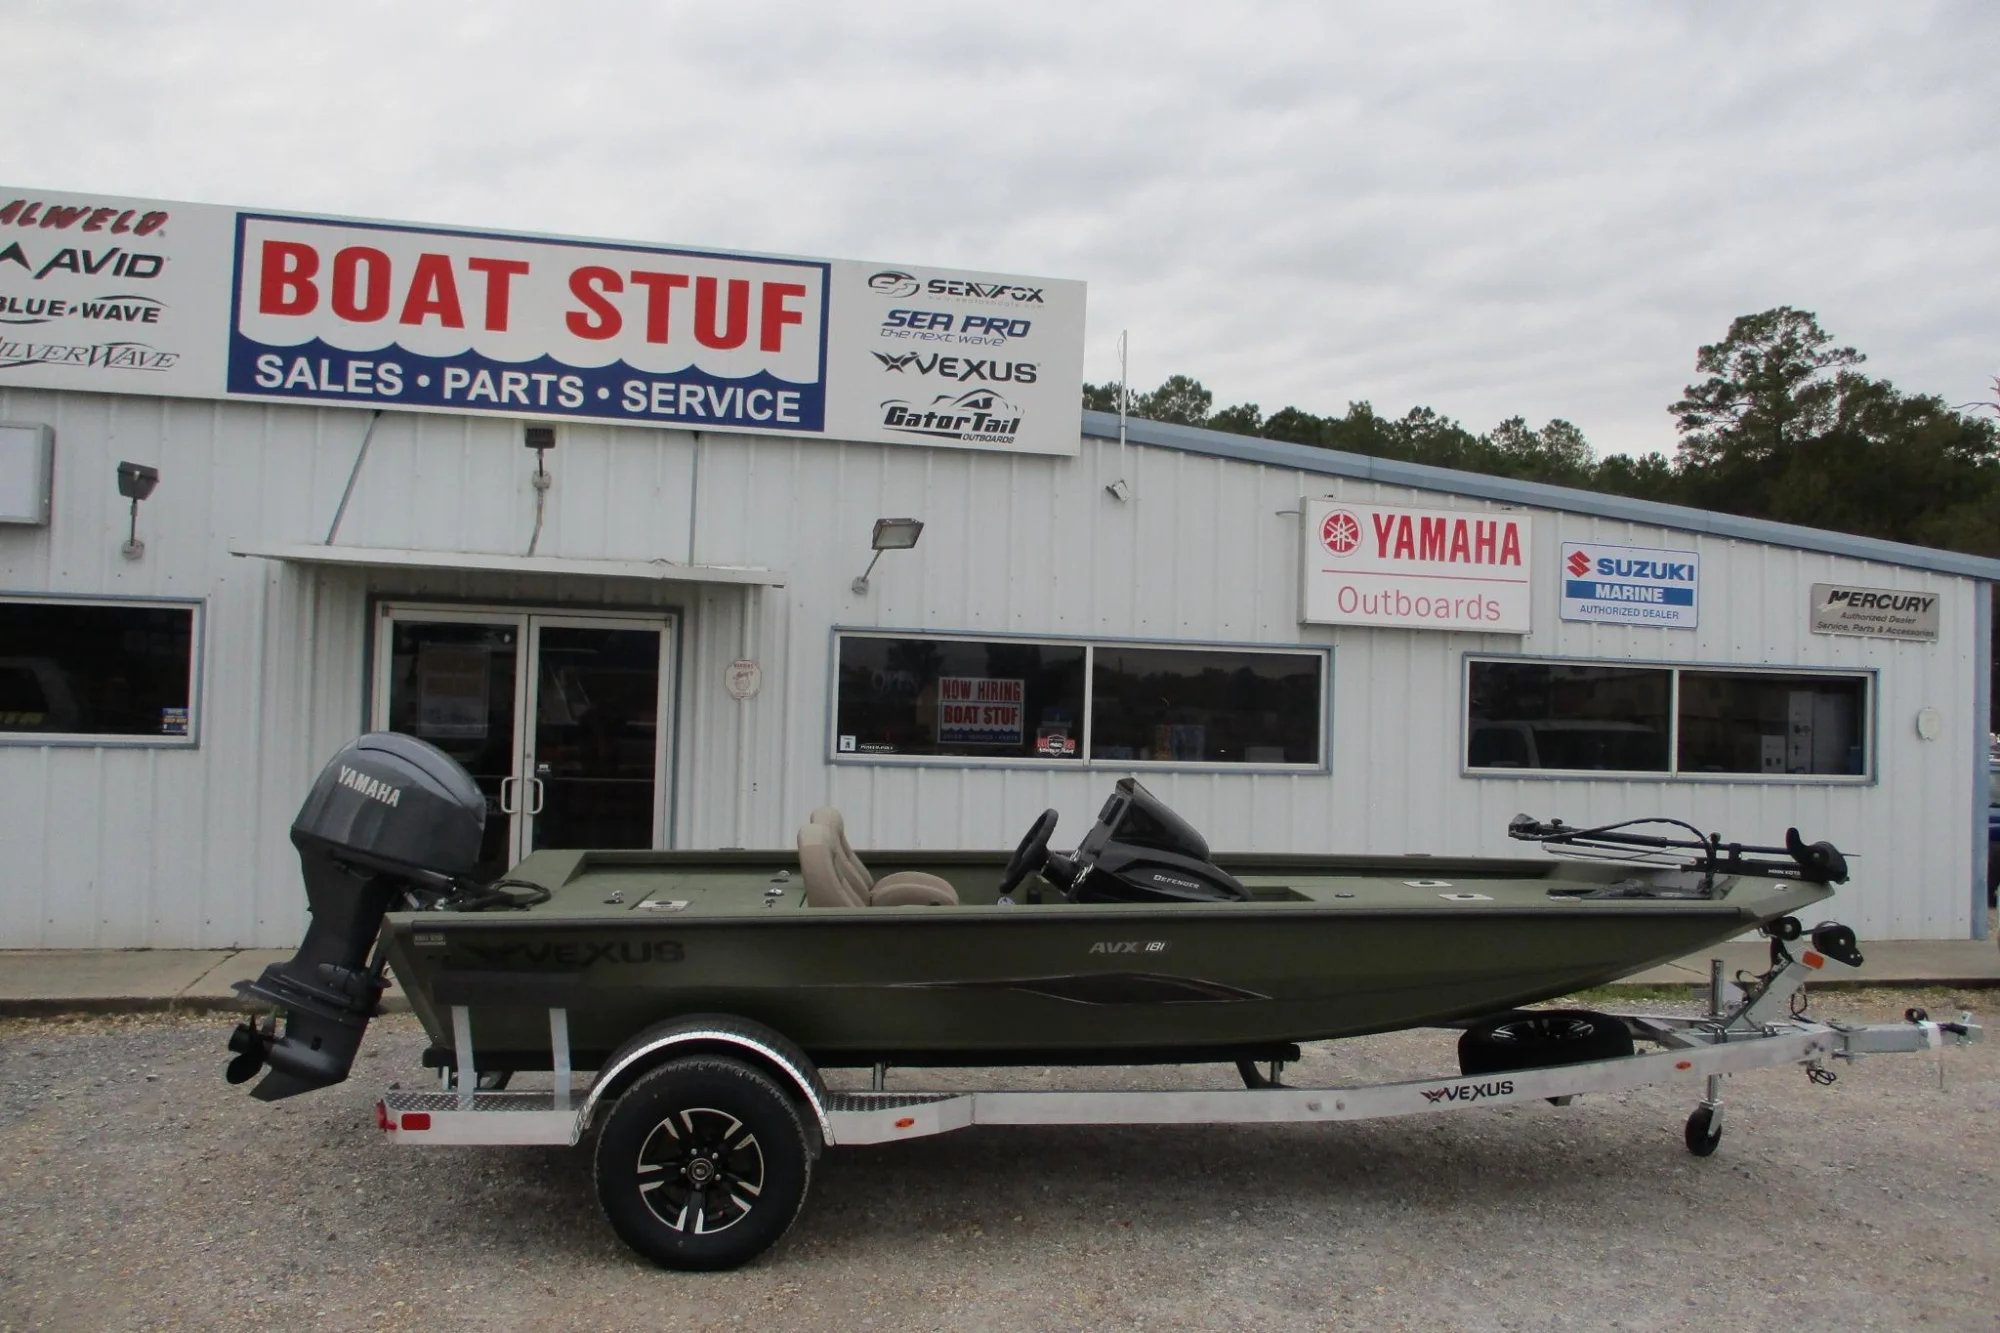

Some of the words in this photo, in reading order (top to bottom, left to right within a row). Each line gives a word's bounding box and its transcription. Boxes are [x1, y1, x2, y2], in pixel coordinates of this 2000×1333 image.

[33, 247, 164, 279] AVID
[259, 240, 530, 332] BOAT
[565, 266, 806, 353] STUF
[882, 309, 954, 332] SEA
[960, 315, 1031, 341] PRO
[880, 328, 910, 339] the
[913, 332, 955, 343] next
[958, 336, 1004, 347] wave
[0, 336, 180, 368] ILVERWAVE
[911, 352, 1037, 383] VEXUS
[255, 354, 404, 396] SALES
[443, 366, 585, 408] PARTS
[621, 380, 801, 424] SERVICE
[883, 406, 1021, 434] GatorTail
[962, 433, 1015, 444] OUTBOARDS
[1372, 513, 1522, 567] YAMAHA
[1596, 558, 1694, 581] SUZUKI
[1337, 586, 1501, 621] Outboards
[1595, 583, 1664, 603] MARINE
[1828, 590, 1934, 613] MERCURY
[1580, 605, 1640, 617] AUTHORIZED
[1642, 609, 1679, 620] DEALER
[1840, 612, 1886, 622] Authorized
[942, 680, 972, 699] NOW
[978, 681, 1021, 701] HIRING
[944, 705, 980, 724] BOAT
[983, 707, 1019, 725] STUF
[338, 764, 401, 807] YAMAHA
[524, 940, 686, 966] VEXUS
[1088, 941, 1139, 953] AVX
[1443, 1080, 1514, 1102] VEXUS
